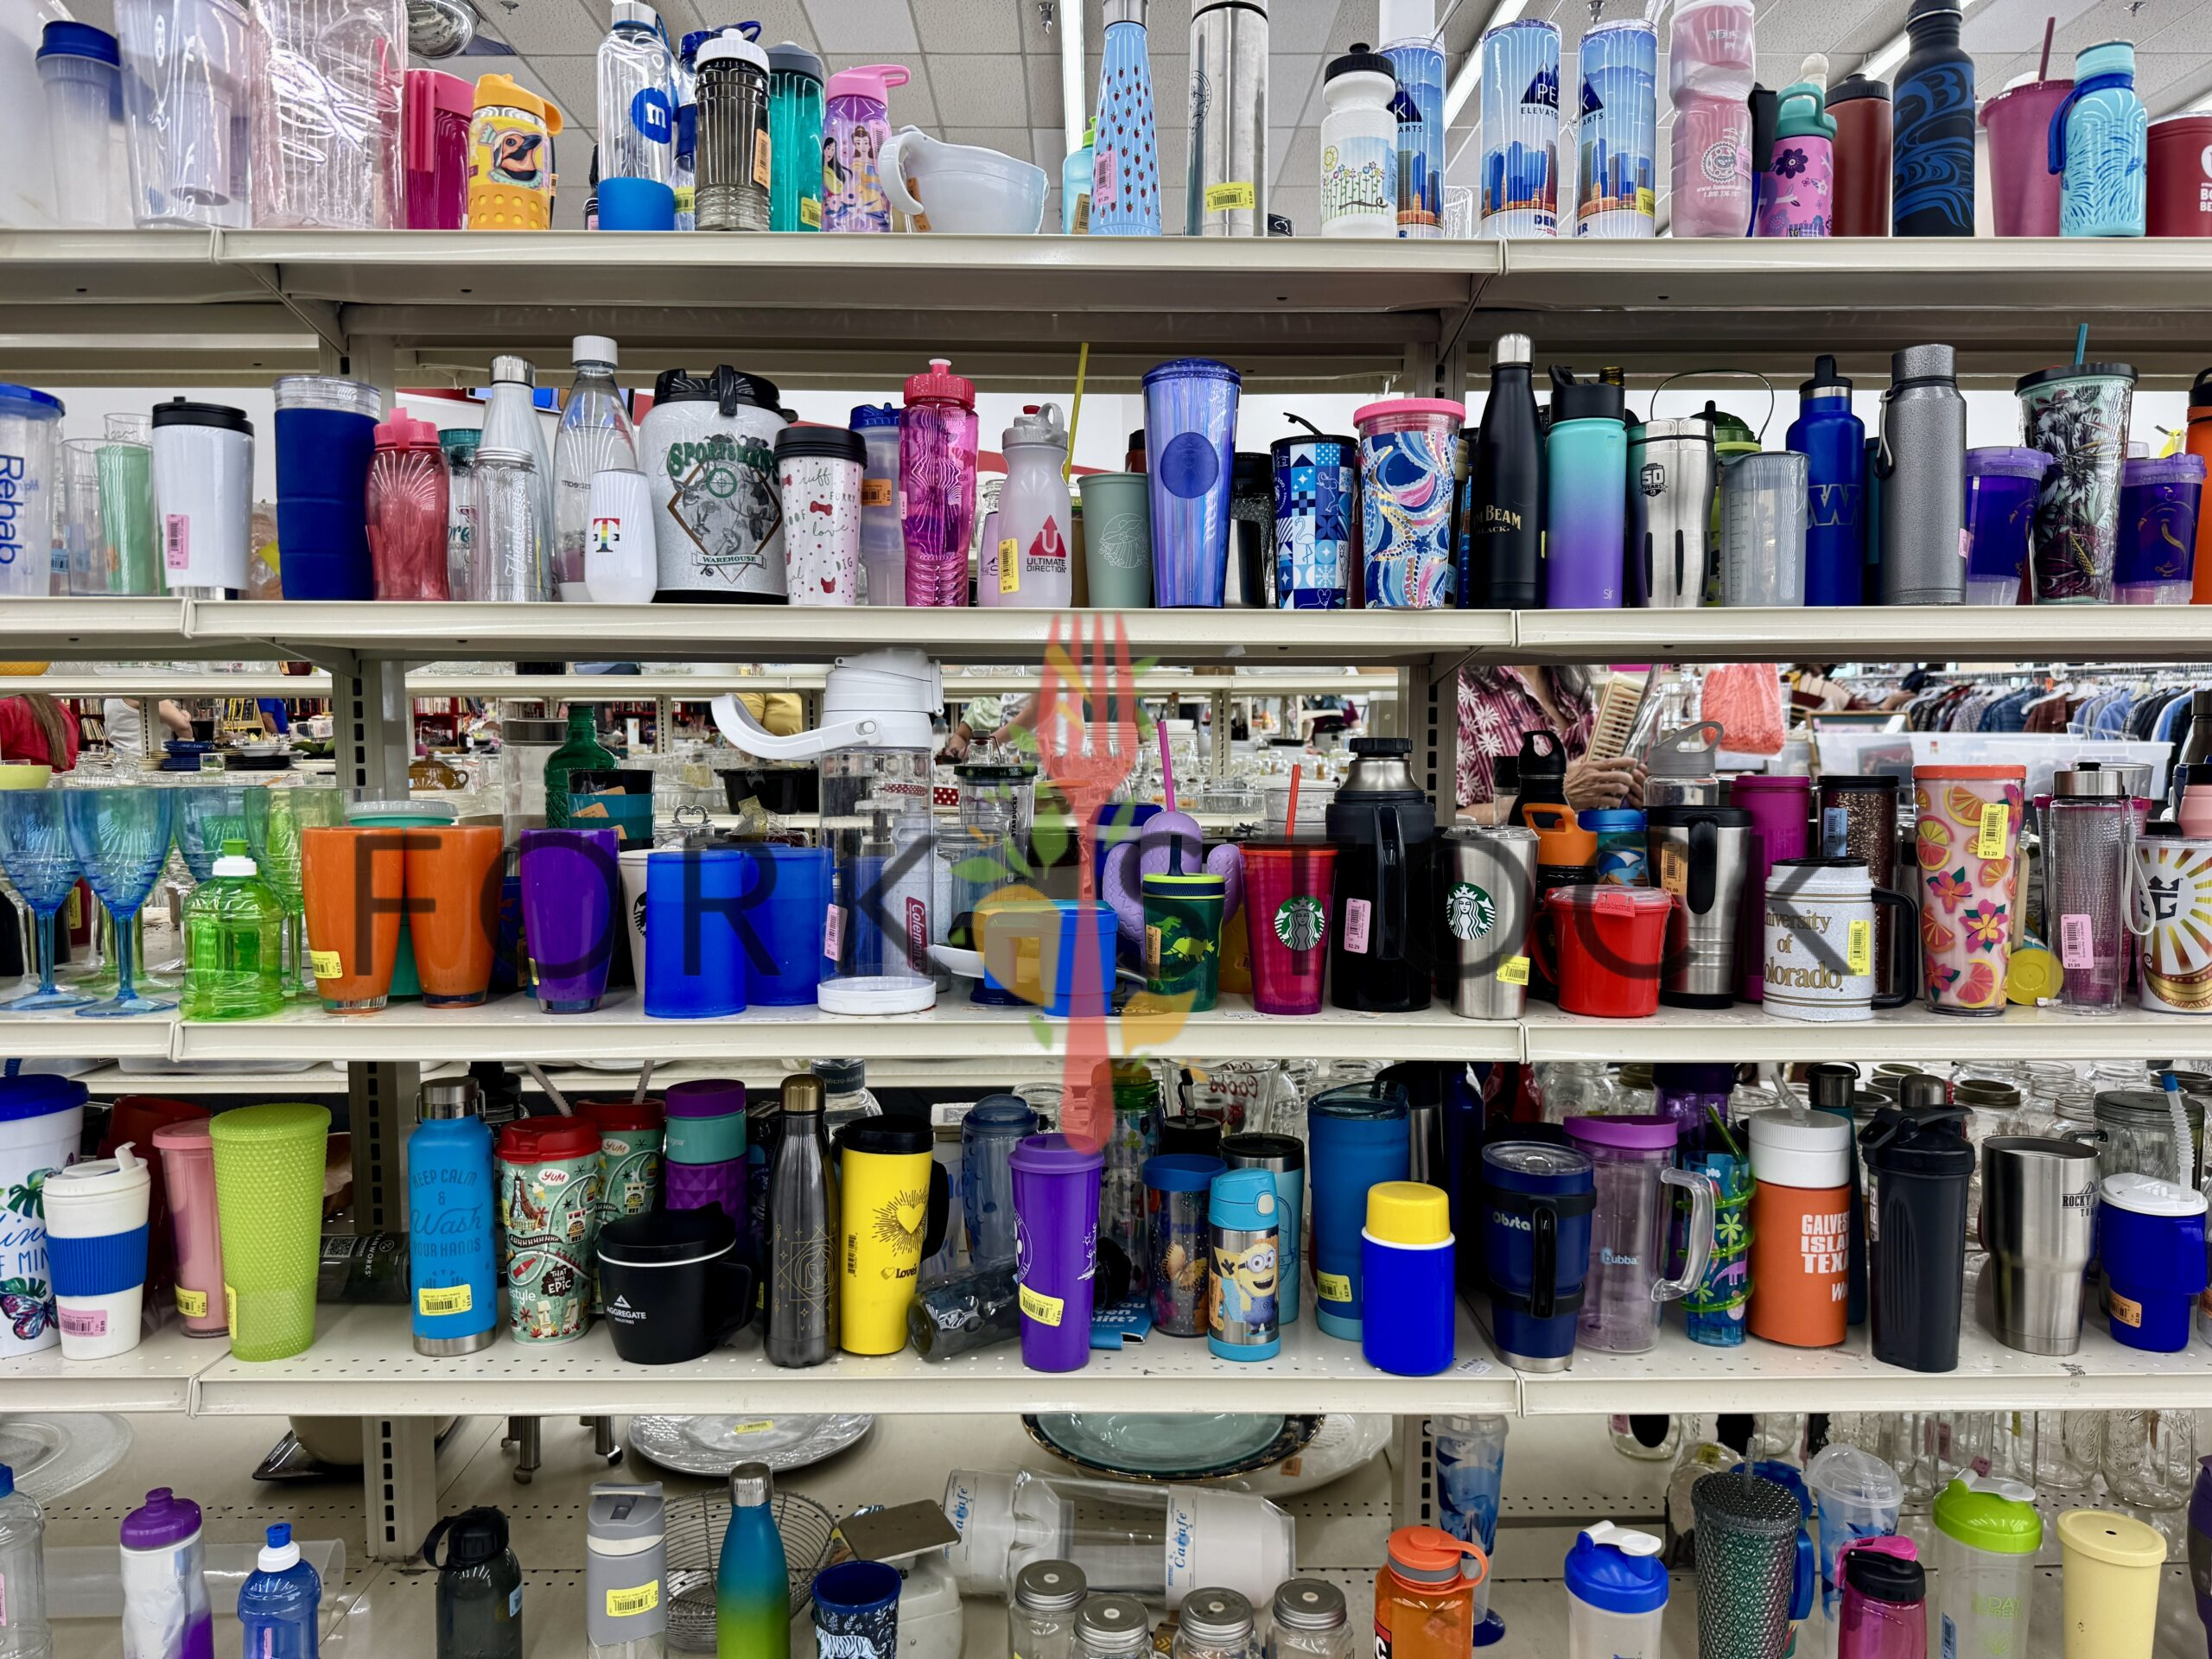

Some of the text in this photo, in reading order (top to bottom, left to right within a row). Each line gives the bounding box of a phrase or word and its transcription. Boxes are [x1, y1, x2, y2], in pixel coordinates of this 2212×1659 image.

[830, 492, 856, 504] FURRY
[0, 454, 24, 564] Rehab
[789, 509, 807, 526] OOF
[1486, 505, 1522, 531] BEAM
[813, 521, 849, 537] love
[702, 556, 757, 566] WAREHOUSE
[1027, 557, 1065, 568] ULTIMATE
[912, 904, 926, 957] Coleman
[1765, 909, 1832, 934] niversity
[1777, 933, 1793, 954] of
[1764, 957, 1842, 989] olorado
[605, 1141, 629, 1153] YUM
[412, 1169, 477, 1190] KEEP CALM
[541, 1171, 567, 1183] YUM
[438, 1192, 446, 1205] &
[2062, 1194, 2092, 1207] ROCKY
[413, 1203, 484, 1236] Wash
[1493, 1211, 1531, 1231] Obsta
[412, 1237, 481, 1258] YOUR HANDS
[1602, 1247, 1637, 1265] bubba
[550, 1268, 568, 1279] THAT
[607, 1305, 647, 1320] AGGREGATE
[955, 1486, 969, 1536] arafe
[1175, 1512, 1189, 1568] Carafe
